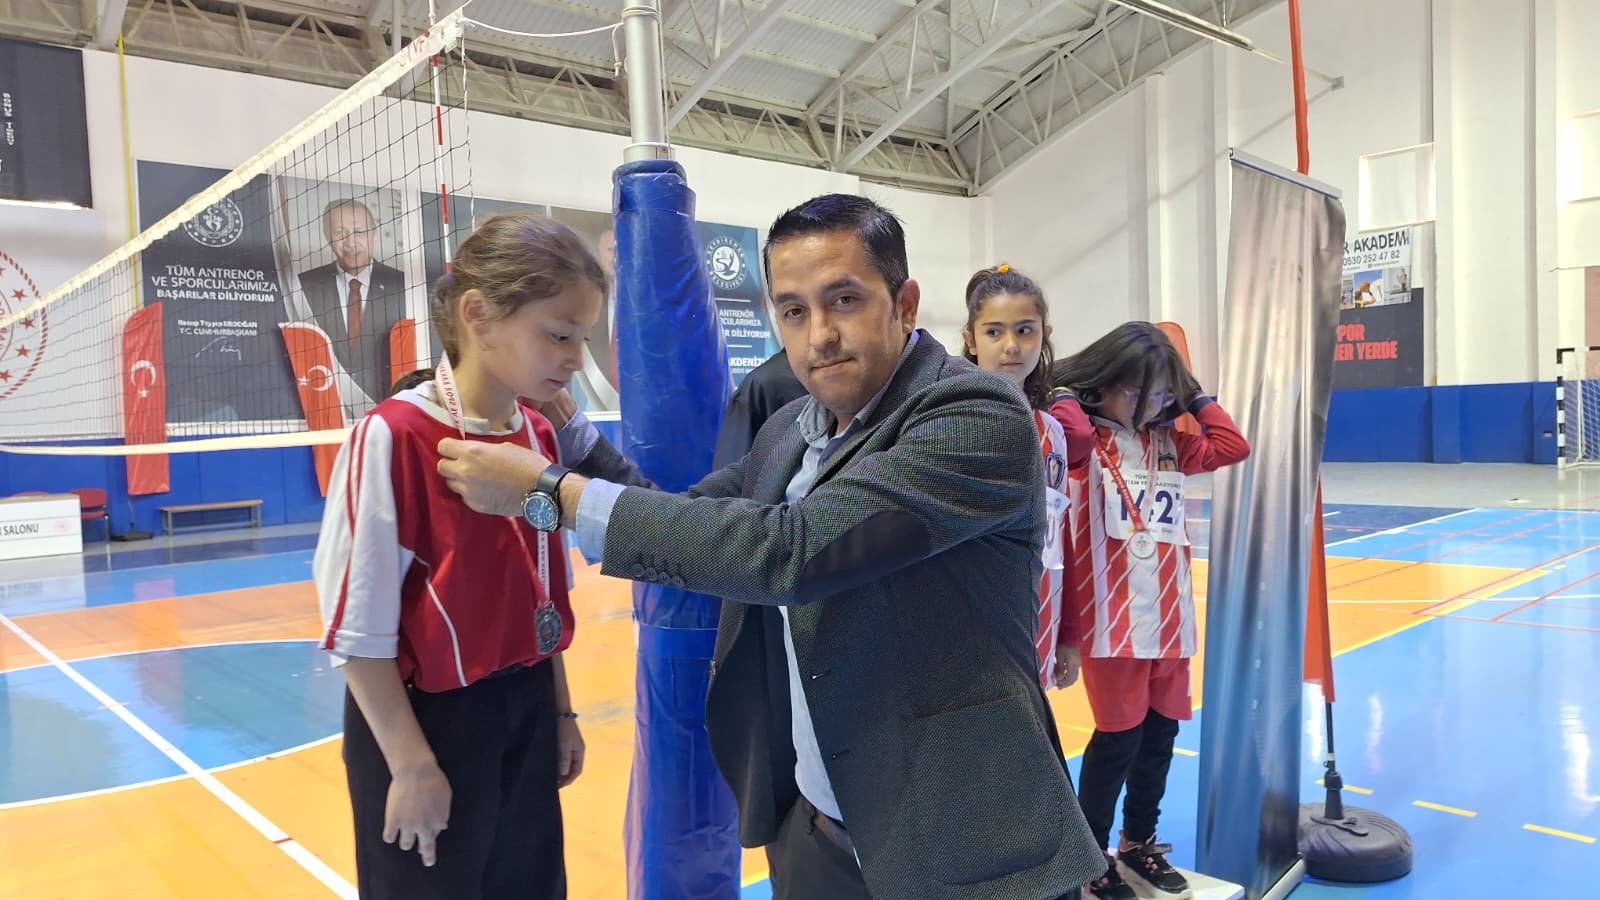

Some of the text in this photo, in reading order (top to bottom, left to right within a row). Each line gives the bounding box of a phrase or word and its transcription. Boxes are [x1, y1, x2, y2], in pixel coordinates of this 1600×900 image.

[1343, 256, 1361, 266] 0530
[1363, 253, 1377, 263] 252
[1379, 251, 1388, 260] 47
[1391, 249, 1400, 259] 82
[166, 264, 264, 281] TÜM ANTRENÖR
[151, 276, 278, 292] VE SPORCULARIMIZA
[156, 289, 275, 303] BAŞARILAR DİLİYORUM
[720, 308, 754, 318] ANTRENÖR
[731, 328, 771, 339] DİLİYORUM
[1356, 340, 1398, 361] YERDE
[3, 523, 40, 536] SALONU
